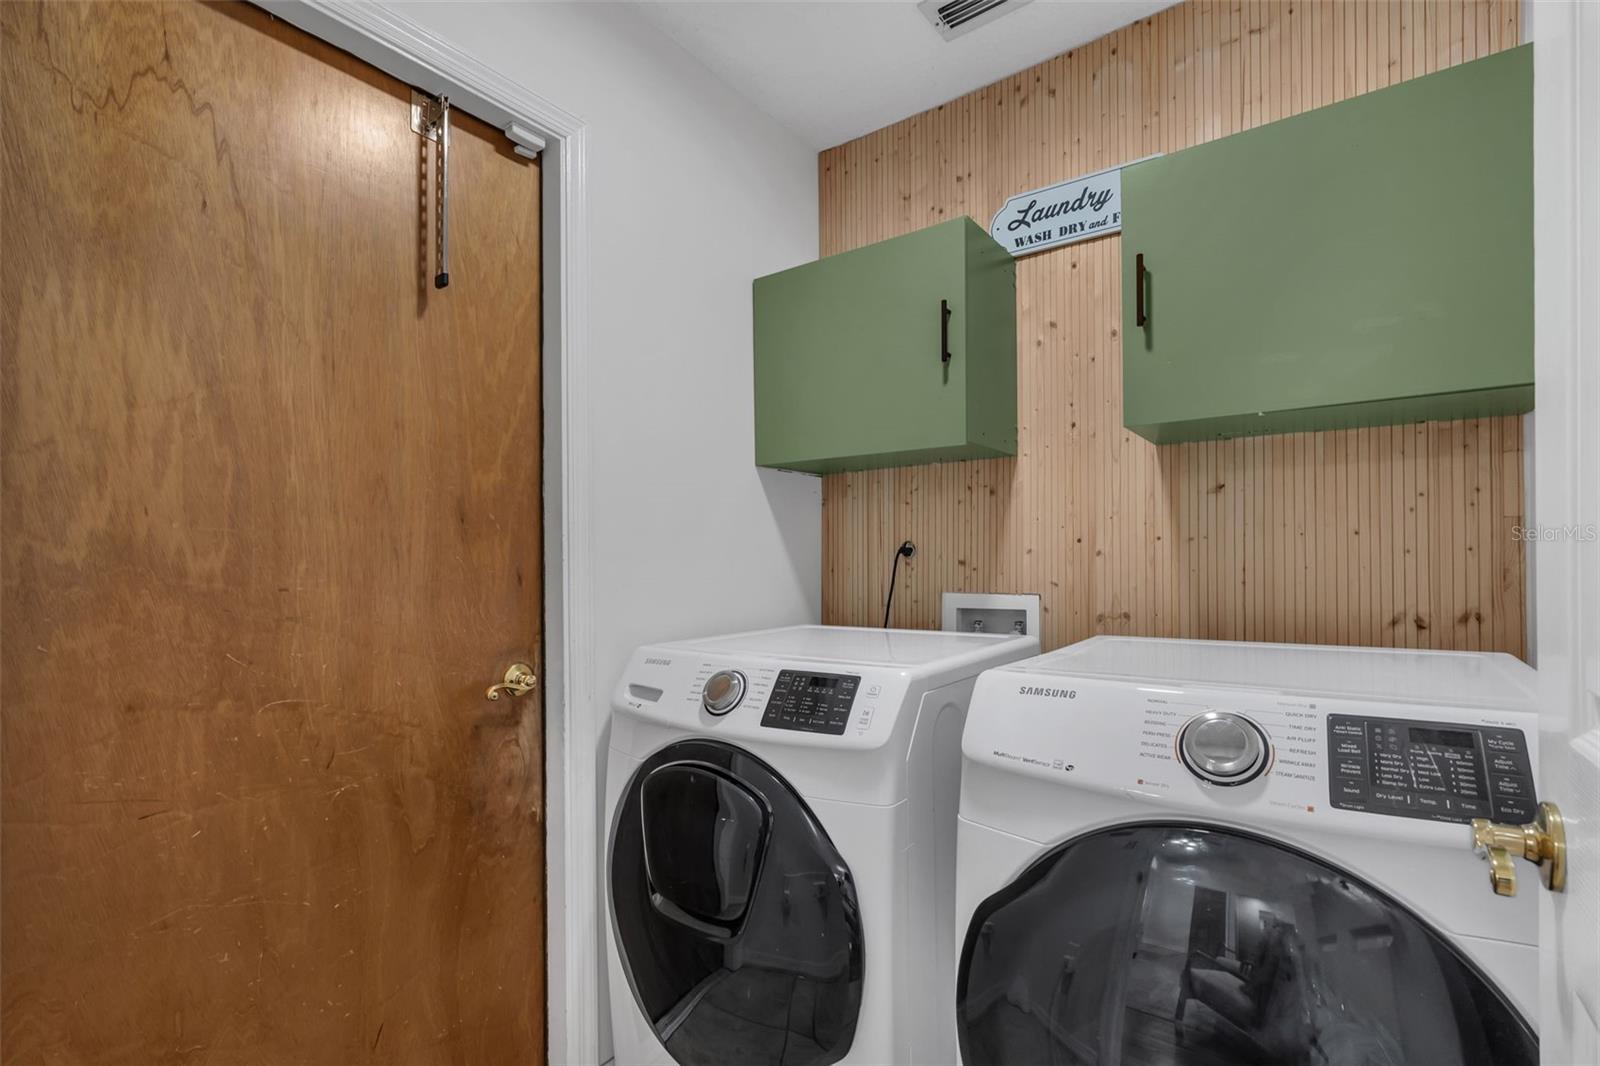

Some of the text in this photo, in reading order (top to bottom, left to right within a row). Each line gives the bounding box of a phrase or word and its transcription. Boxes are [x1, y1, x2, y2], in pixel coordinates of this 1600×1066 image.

[1007, 186, 1114, 232] Laundry
[1014, 211, 1121, 248] WASH DRY and F
[1019, 686, 1077, 699] SAMSUNG
